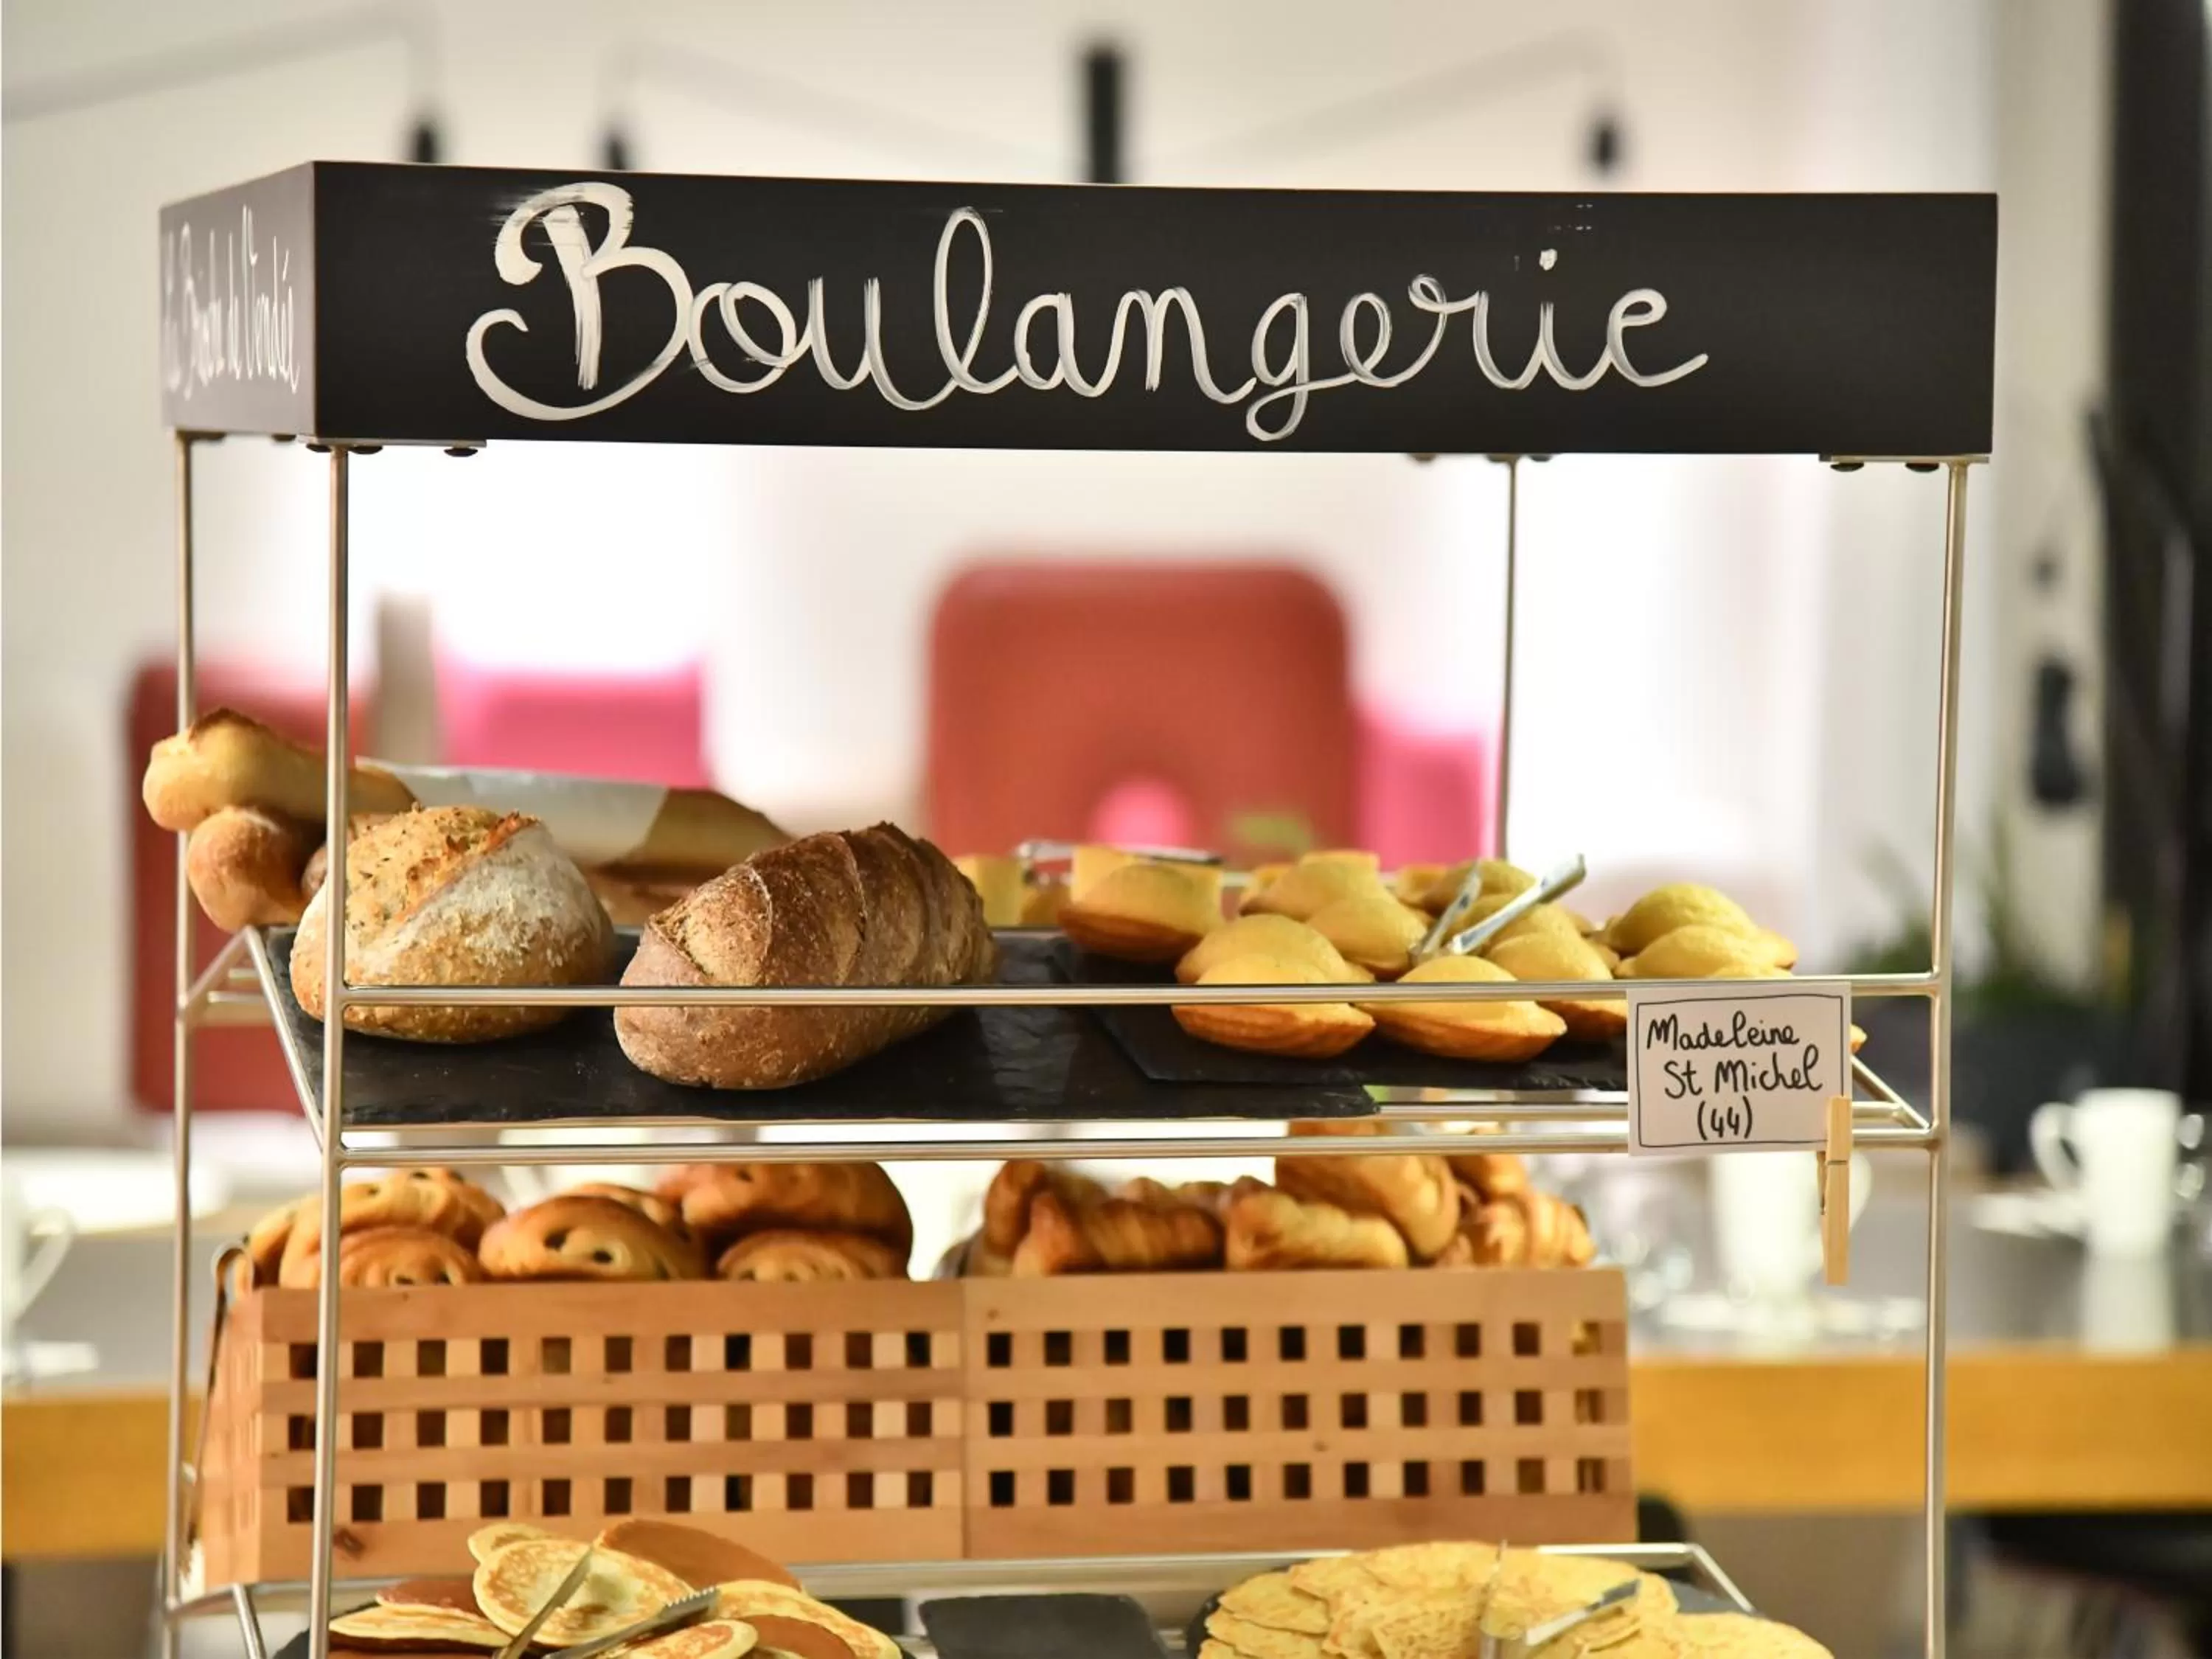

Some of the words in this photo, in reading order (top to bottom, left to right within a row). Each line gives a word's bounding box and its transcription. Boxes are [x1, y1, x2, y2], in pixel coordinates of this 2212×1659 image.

[466, 182, 1708, 442] Boulangerie
[1646, 1010, 1800, 1051] Madeleine
[1663, 1060, 1703, 1099] St
[1714, 1044, 1823, 1092] Michel
[1697, 1095, 1753, 1141] (44)
